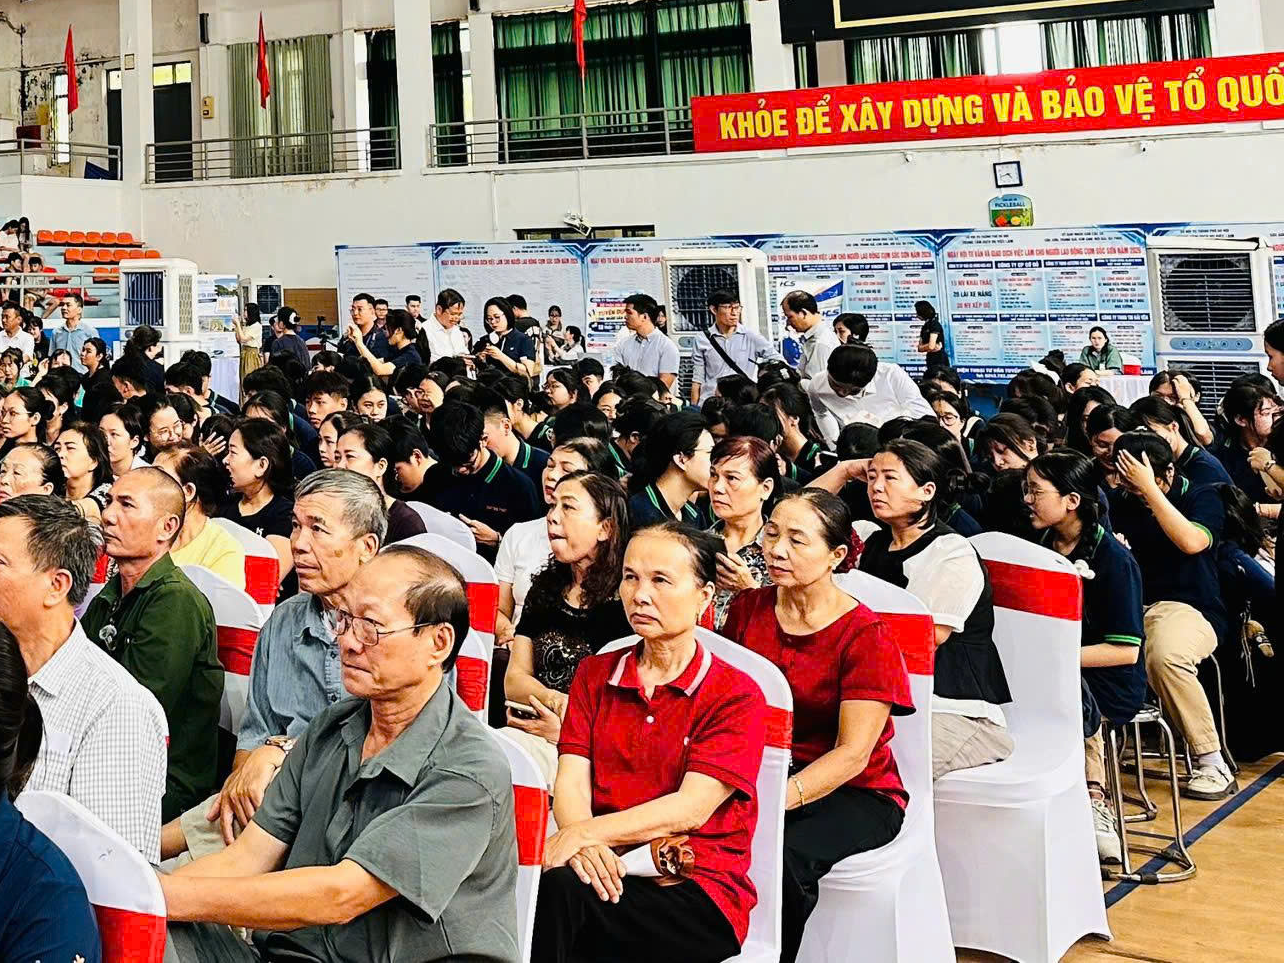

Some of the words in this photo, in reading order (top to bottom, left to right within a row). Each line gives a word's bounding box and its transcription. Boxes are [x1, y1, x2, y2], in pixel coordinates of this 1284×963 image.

[719, 98, 789, 140] KHỎE
[796, 94, 832, 135] ĐỂ
[839, 96, 893, 133] XÂY
[903, 94, 985, 133] DỰNG
[991, 86, 1033, 123] VÀ
[1041, 75, 1105, 120] BẢO
[1114, 76, 1156, 121] VỆ
[1164, 66, 1206, 112] TỔ
